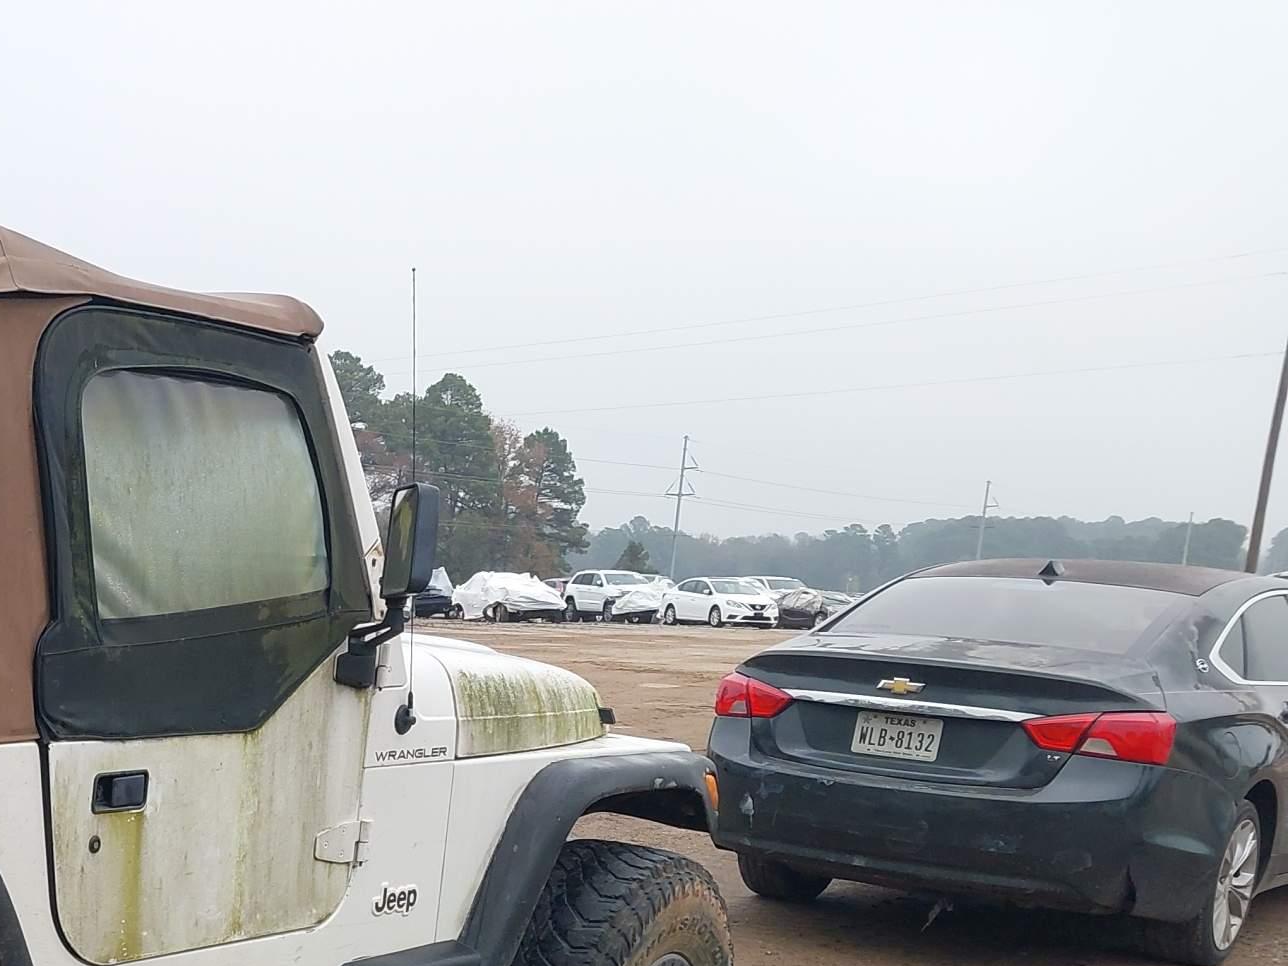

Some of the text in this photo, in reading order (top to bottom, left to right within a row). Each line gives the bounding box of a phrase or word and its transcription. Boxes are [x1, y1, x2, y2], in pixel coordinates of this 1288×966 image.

[884, 716, 916, 728] TEXAS
[375, 747, 448, 762] WRANGLER
[374, 887, 417, 913] Jeep
